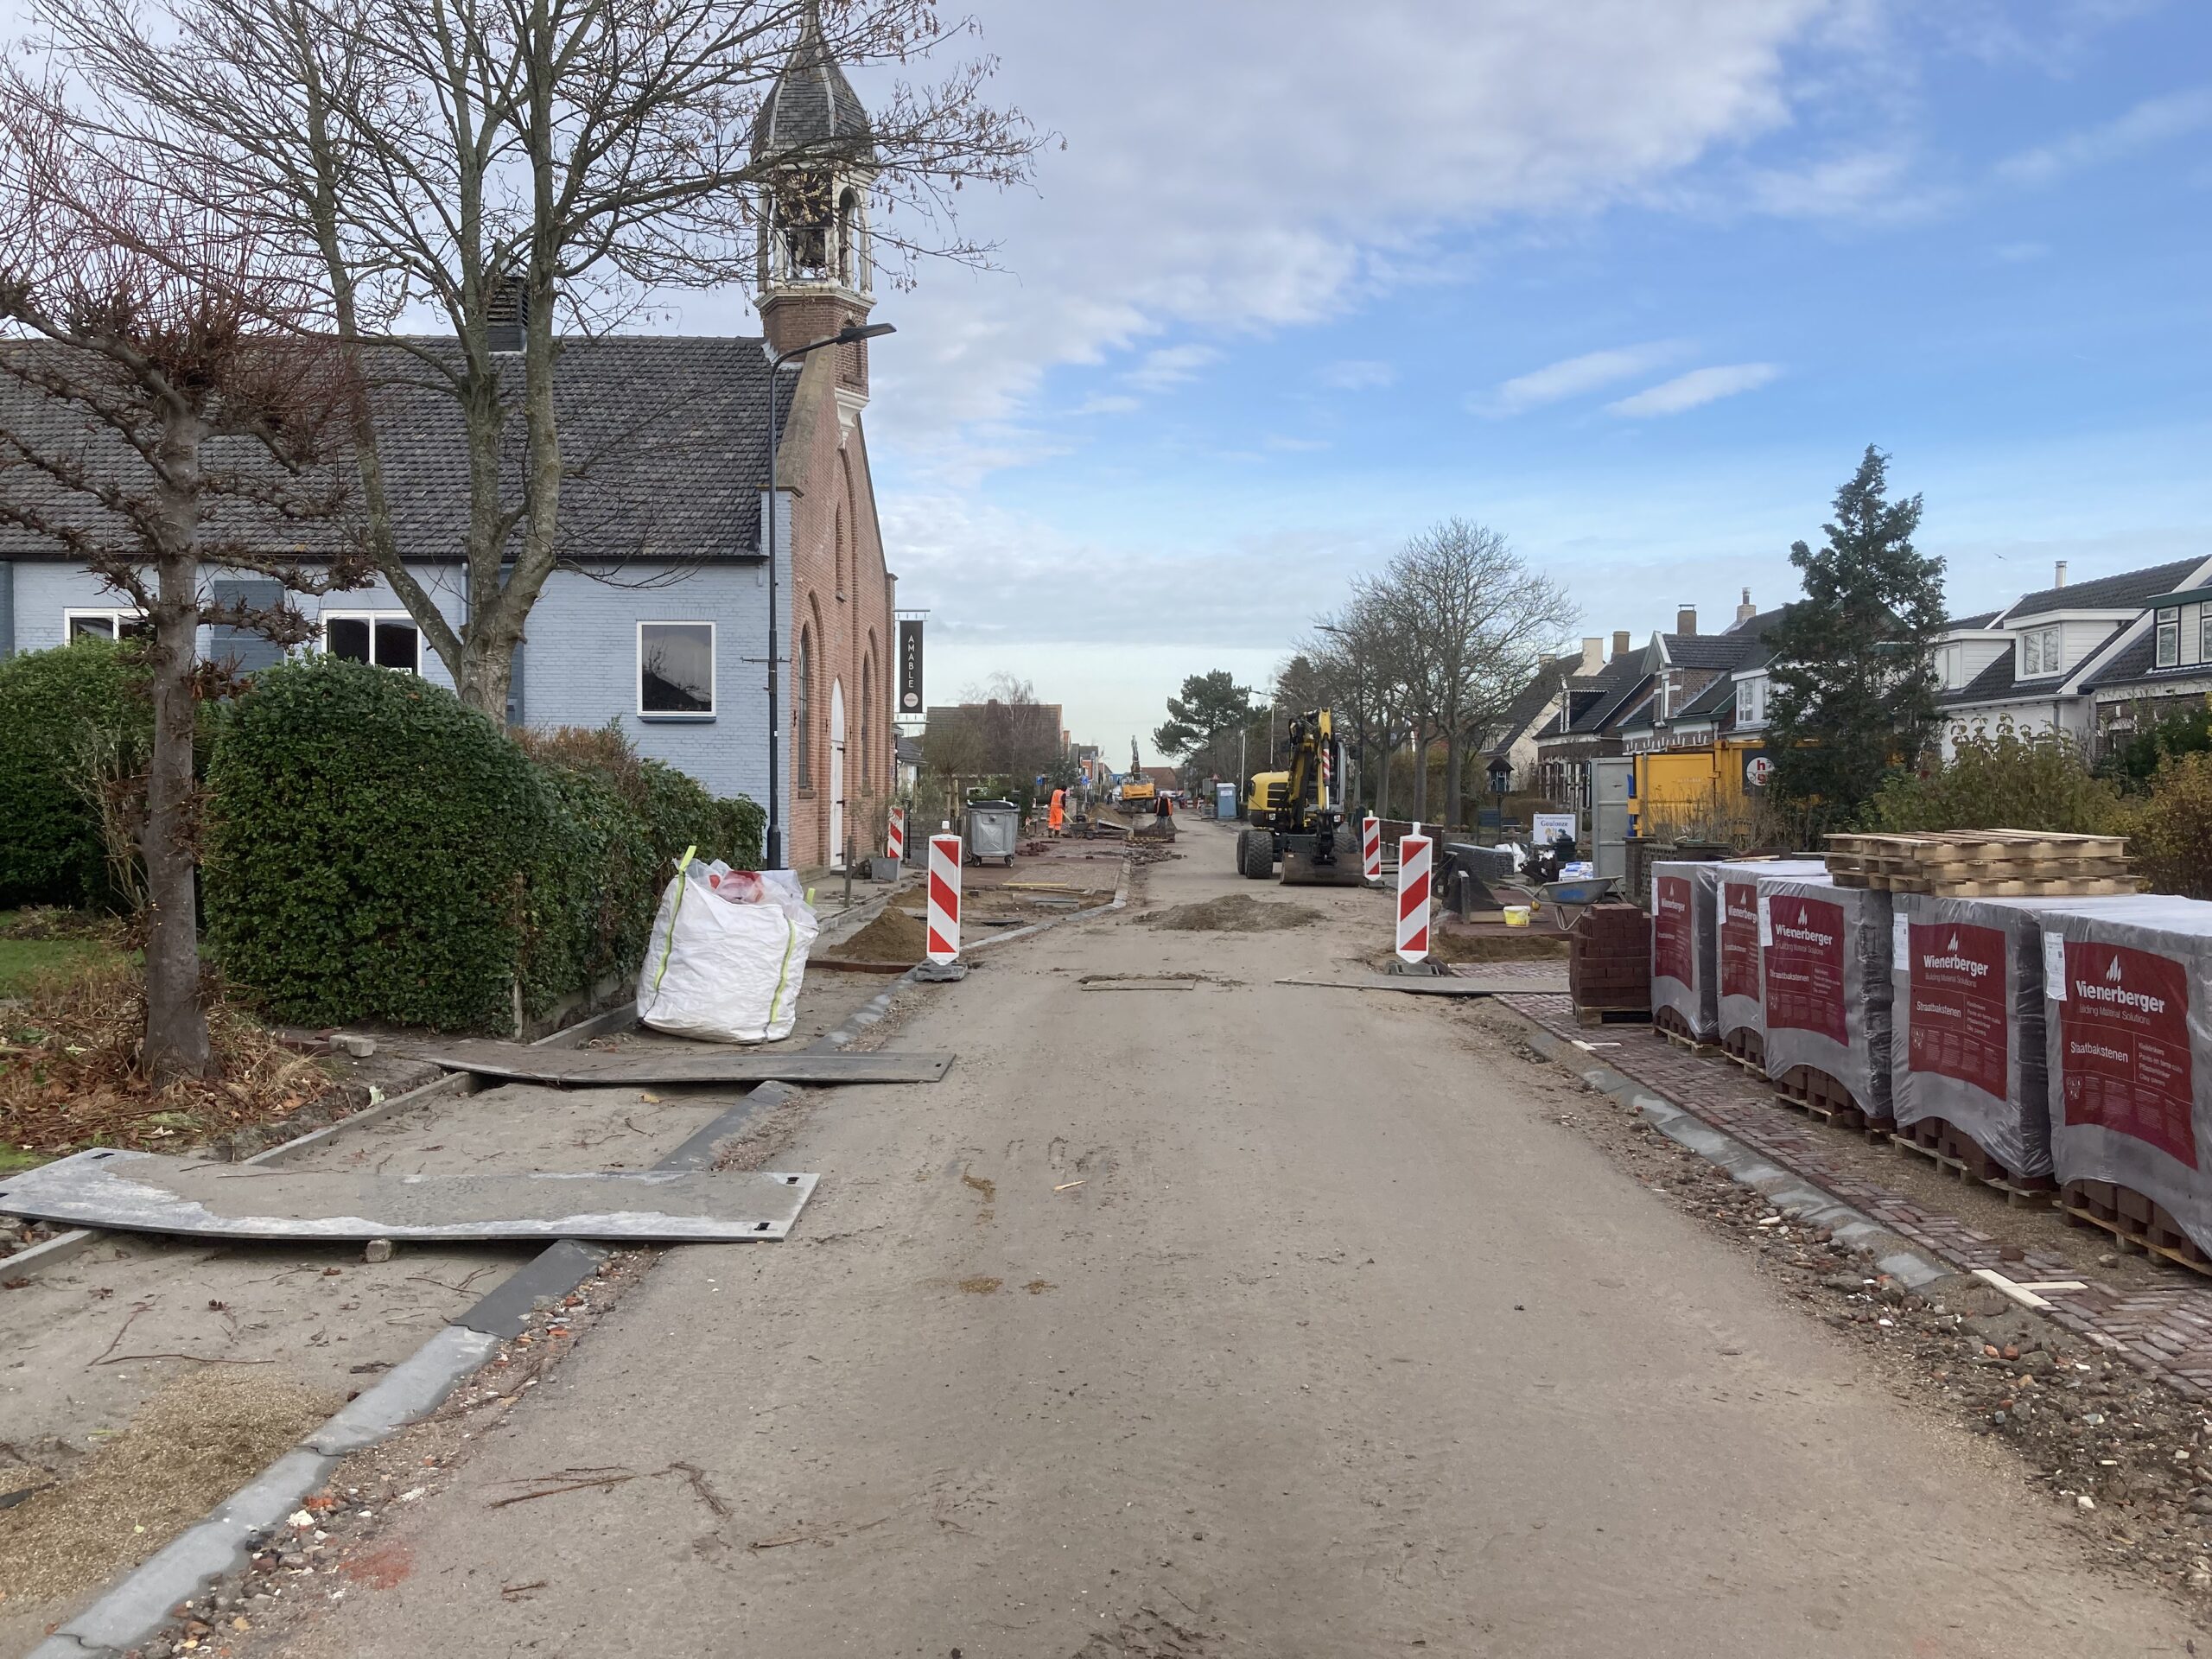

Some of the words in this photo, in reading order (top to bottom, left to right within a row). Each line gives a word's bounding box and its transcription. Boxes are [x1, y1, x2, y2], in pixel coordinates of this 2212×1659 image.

[1728, 905, 1757, 924] Wienerberg
[1775, 923, 1833, 946] Wienerberger
[1923, 954, 1989, 977] Wienerberger
[1916, 1001, 1961, 1018] Straatbakstenen
